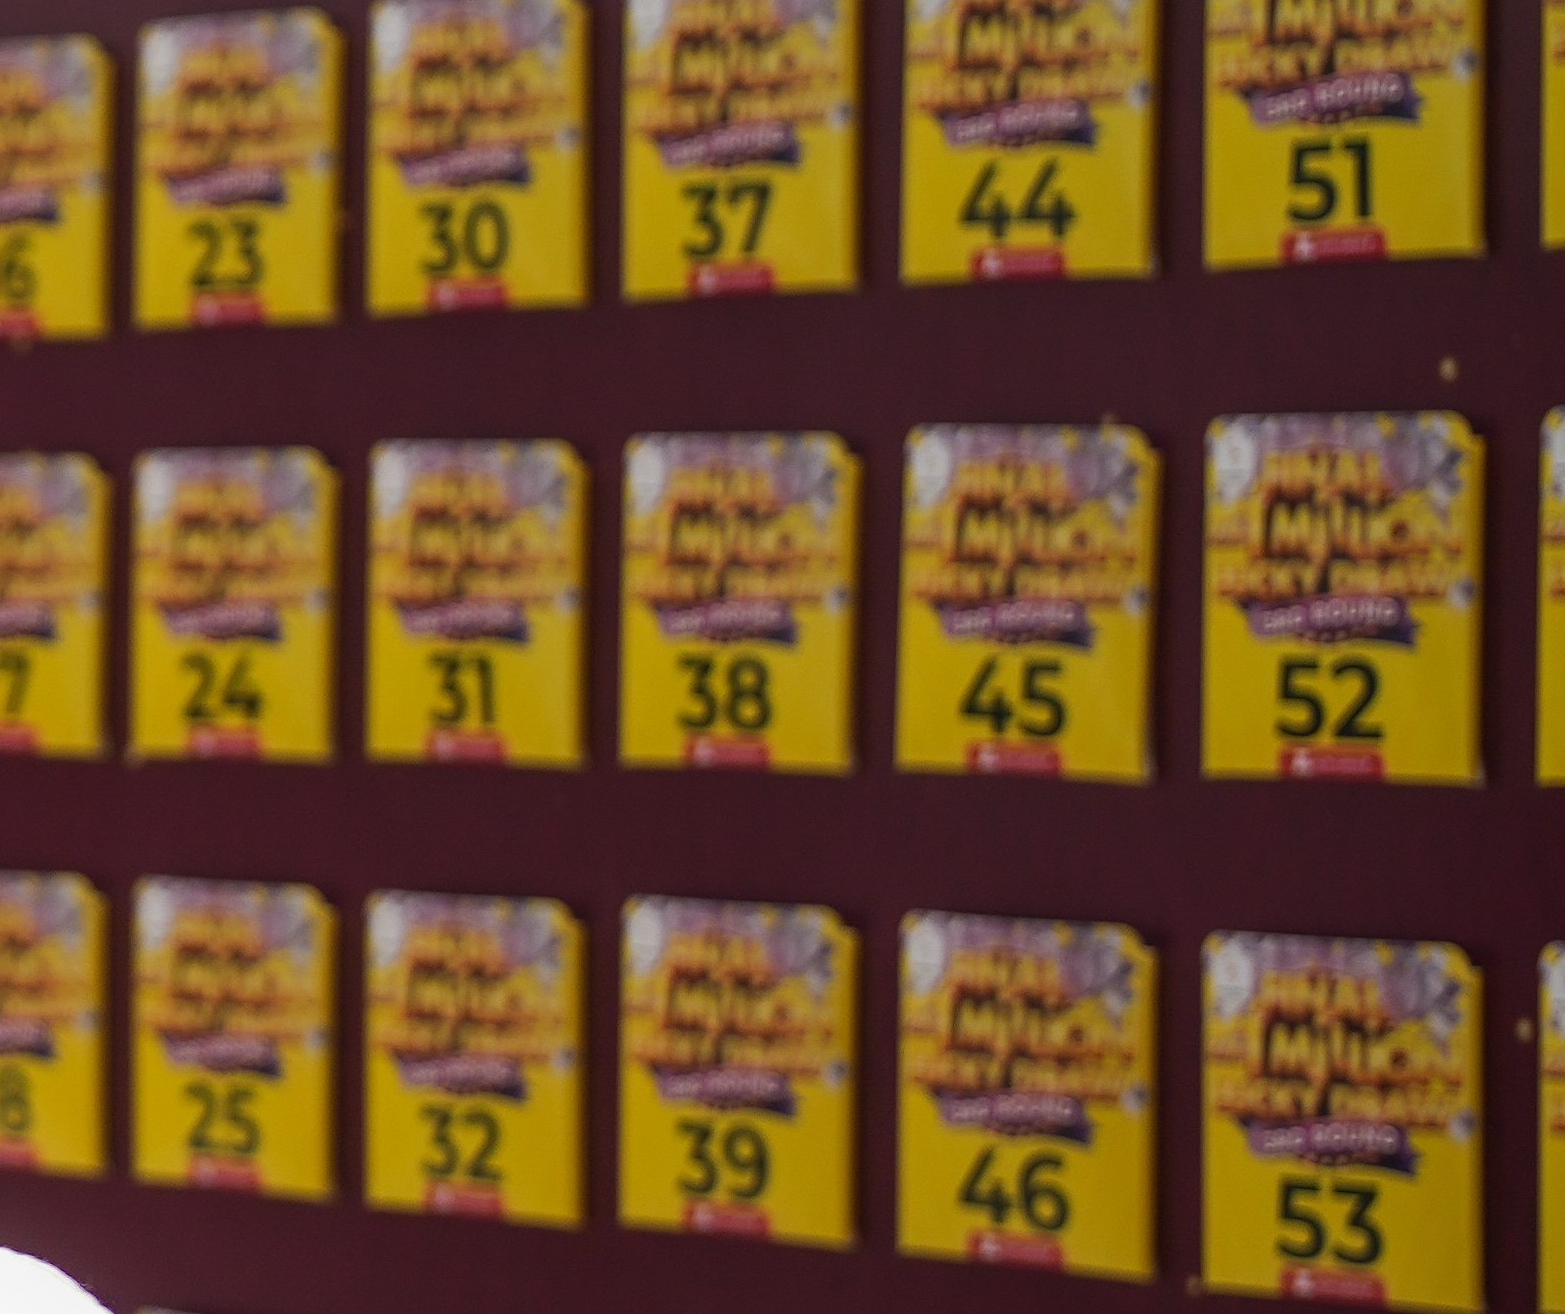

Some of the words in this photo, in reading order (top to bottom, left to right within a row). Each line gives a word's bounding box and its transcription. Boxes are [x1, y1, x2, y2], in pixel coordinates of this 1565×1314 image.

[960, 162, 1076, 240] 44
[1288, 140, 1375, 222] 51
[189, 220, 263, 290] 23
[422, 201, 510, 278] 30
[683, 183, 773, 263] 37
[184, 655, 265, 726] 24
[430, 653, 495, 728] 31
[679, 656, 773, 734] 38
[959, 662, 1067, 739] 45
[1276, 660, 1384, 739] 52
[185, 1083, 261, 1154] 25
[422, 1106, 502, 1181] 32
[678, 1123, 771, 1201] 39
[959, 1151, 1073, 1232] 46
[1278, 1182, 1383, 1265] 53
